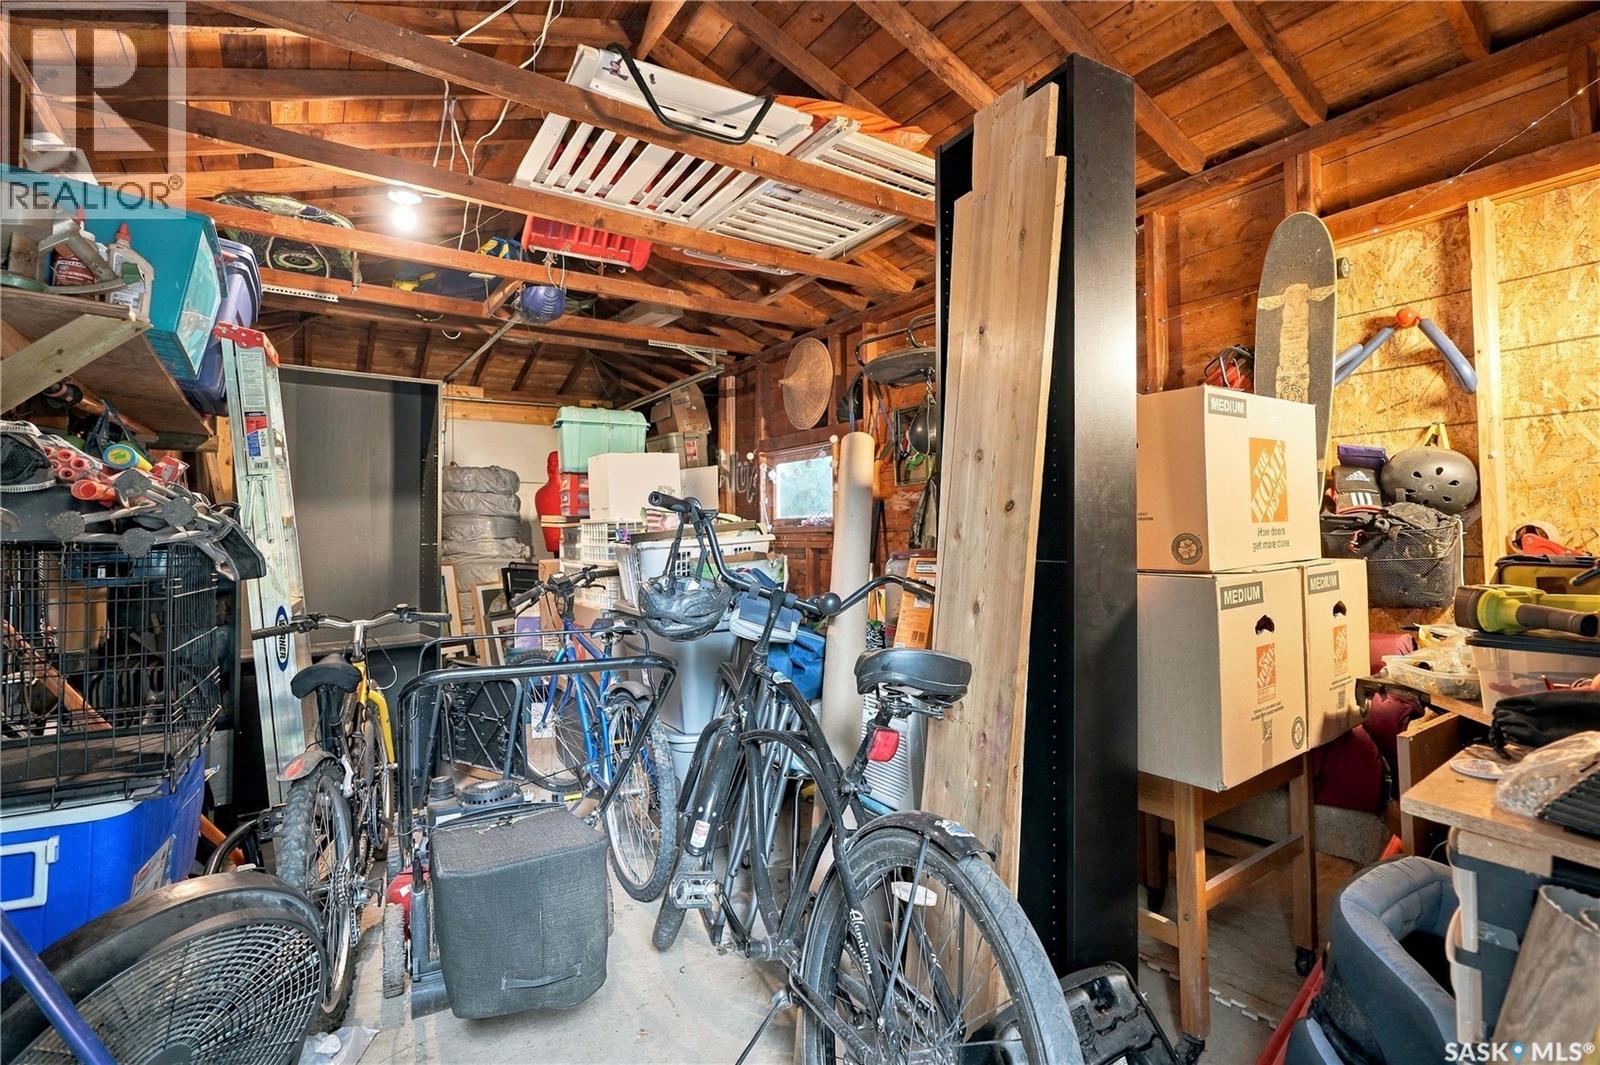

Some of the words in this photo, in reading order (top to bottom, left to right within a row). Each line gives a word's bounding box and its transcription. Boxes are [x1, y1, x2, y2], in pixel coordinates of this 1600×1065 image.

[1210, 397, 1246, 416] MEDIUM
[1310, 574, 1338, 591] MEDIUM
[1223, 585, 1261, 605] MEDIUM
[848, 908, 873, 975] Aluminum
